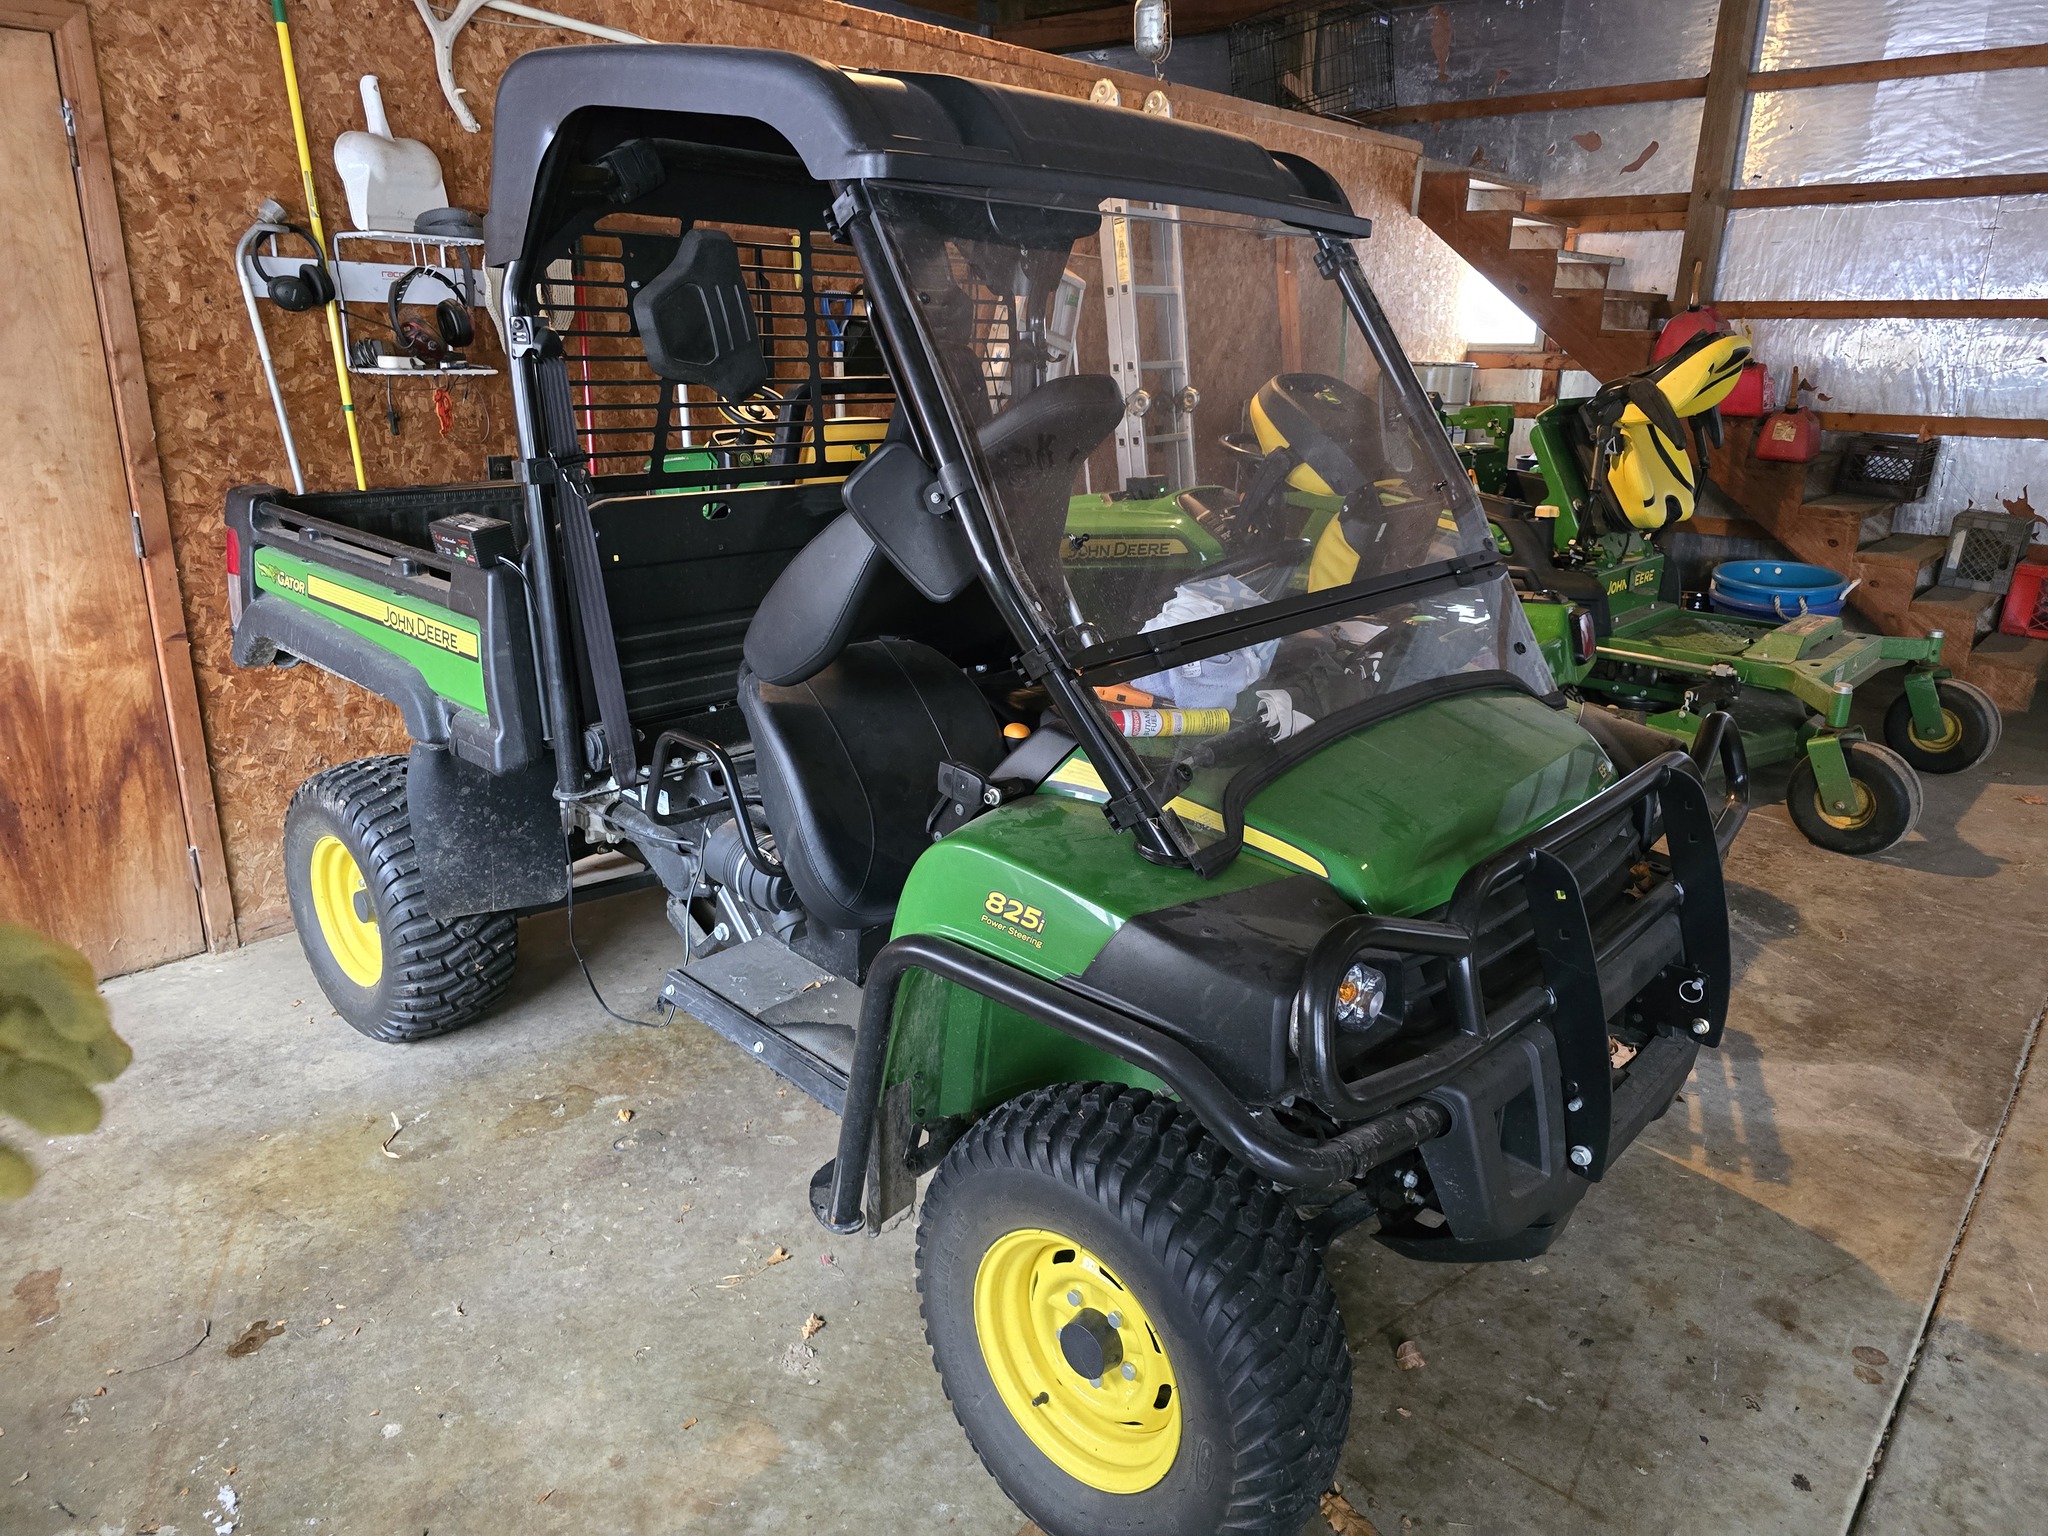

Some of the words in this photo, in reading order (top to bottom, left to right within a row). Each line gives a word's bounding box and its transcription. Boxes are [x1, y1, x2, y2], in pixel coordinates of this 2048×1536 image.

[1113, 541, 1170, 557] DEERE
[277, 572, 306, 595] GATOR
[1634, 569, 1655, 587] EERE
[383, 606, 415, 634] JOHN
[417, 617, 458, 649] DEERE
[1143, 709, 1151, 736] BUTANE
[984, 890, 1047, 934] 825i
[981, 914, 1007, 931] Power
[1007, 926, 1044, 949] Steering
